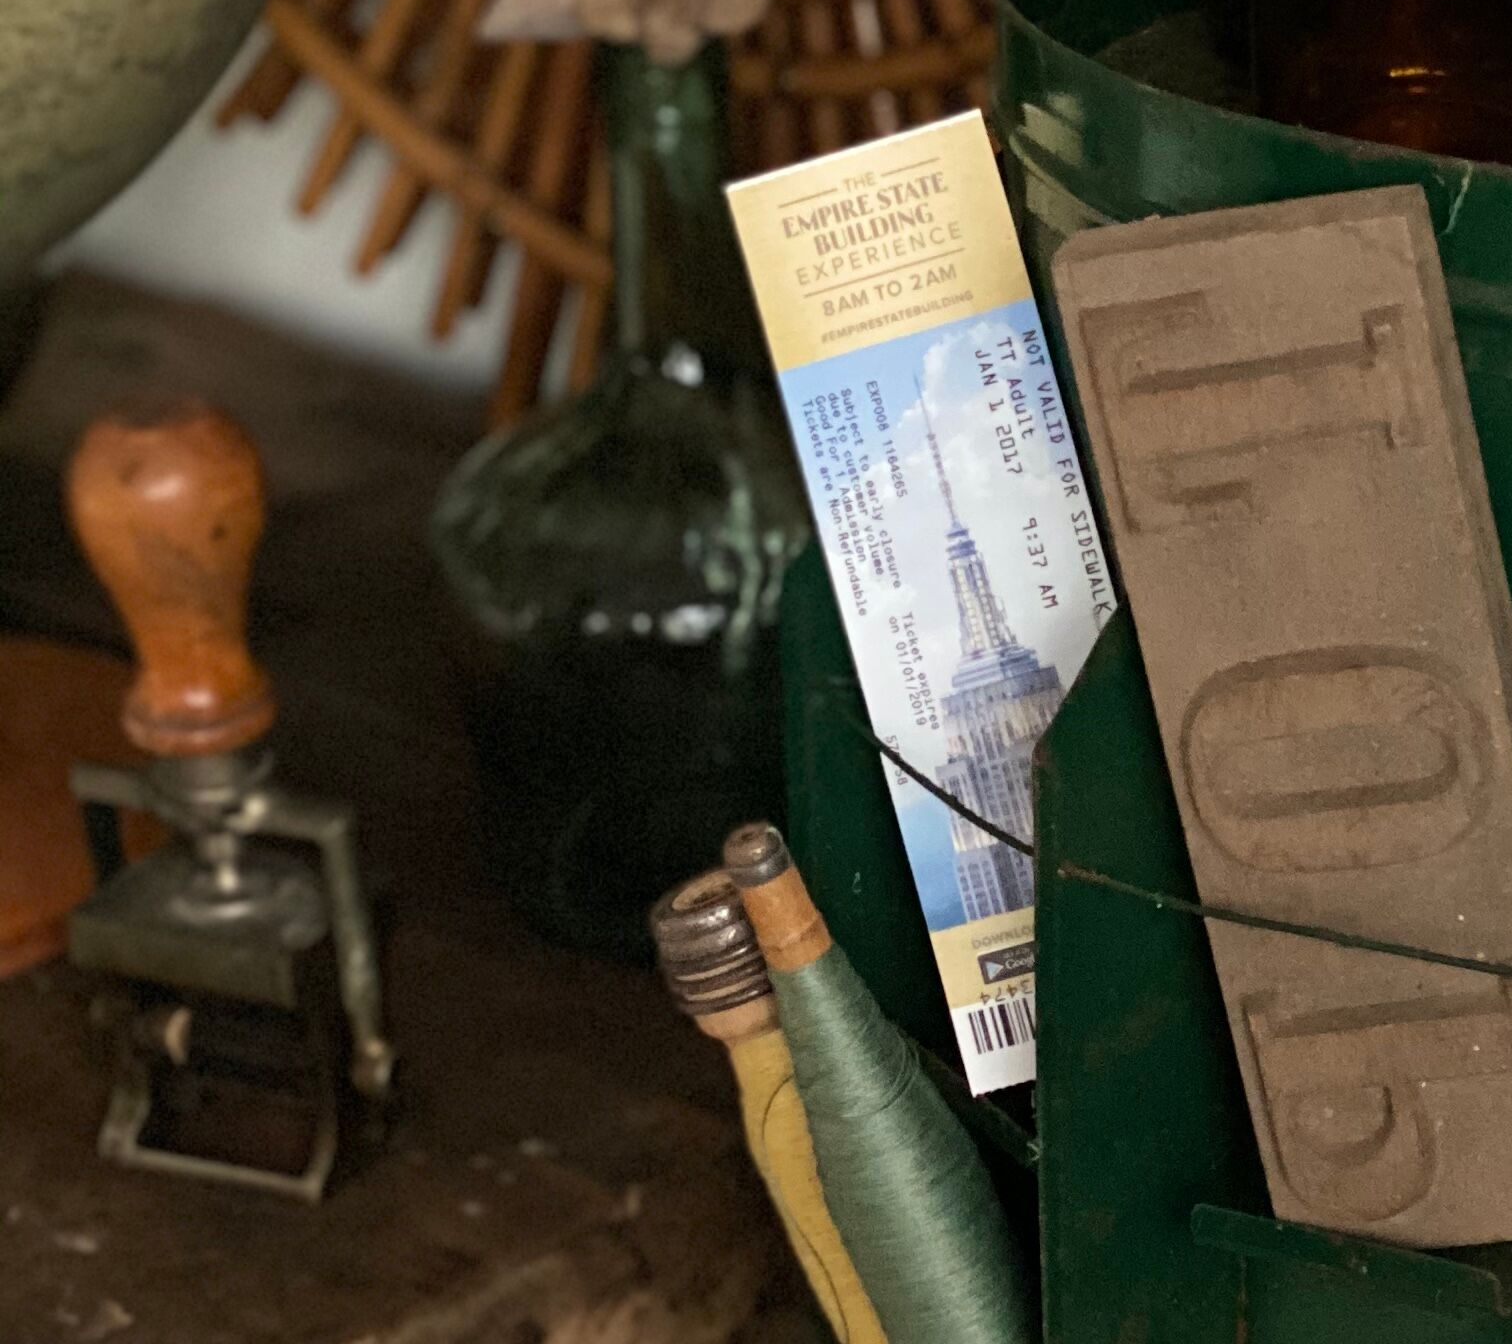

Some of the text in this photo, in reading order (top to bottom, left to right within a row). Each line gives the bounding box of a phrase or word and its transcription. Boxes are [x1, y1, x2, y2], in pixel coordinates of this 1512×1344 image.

[782, 171, 948, 239] EMPIRE STATE
[843, 171, 877, 192] THE
[795, 220, 962, 286] EXPERIENCE
[814, 202, 933, 256] BUILDING
[821, 289, 974, 344] #EMPIRESTATEBUILDING
[823, 263, 957, 316] 8AM TO 2AM
[815, 395, 833, 430] Good
[827, 436, 840, 462] For
[997, 337, 1035, 440] TT Adult
[802, 399, 824, 458] Tickets
[819, 467, 833, 491] are
[827, 392, 884, 575] due to customer volume
[841, 388, 901, 589] Subject to early closure
[975, 350, 1060, 609] JAN 1 2017 9:37 AM
[1022, 329, 1113, 616] NOT VALID FOR SIDEWALK
[888, 616, 927, 726] on 01/01/2019
[902, 612, 940, 731] Ticket expires
